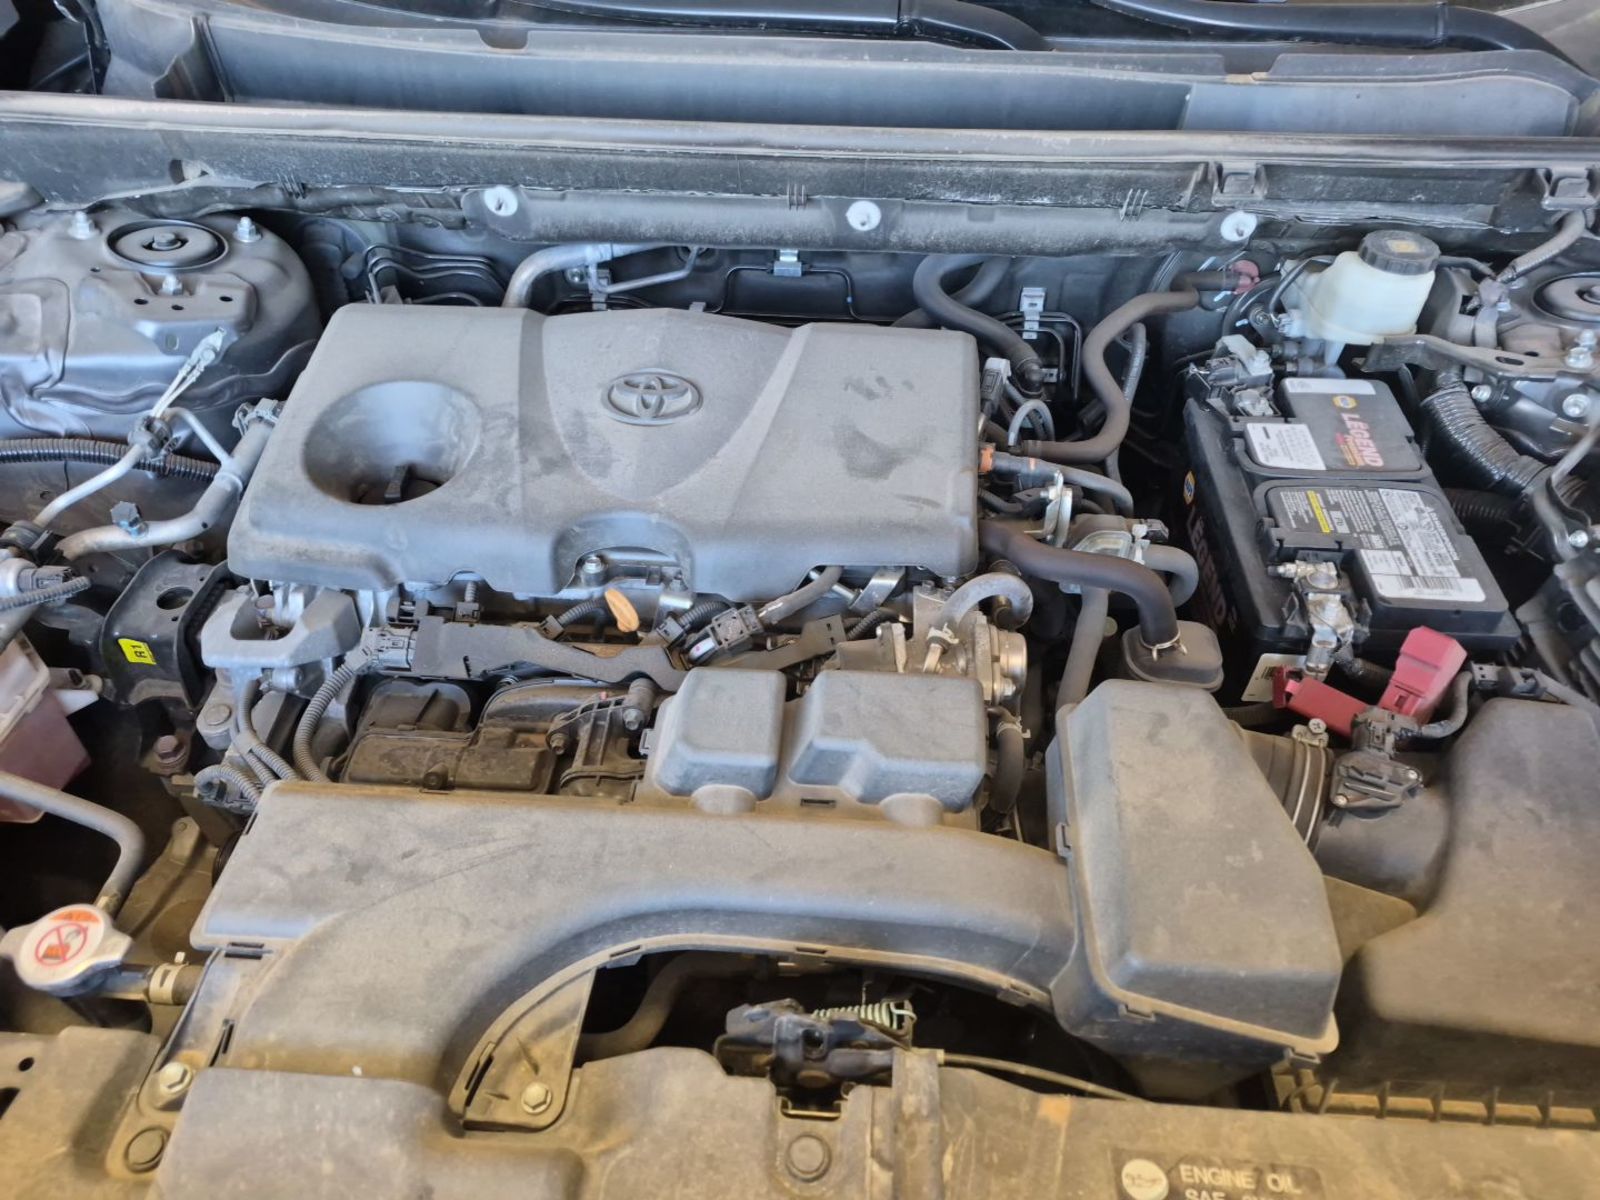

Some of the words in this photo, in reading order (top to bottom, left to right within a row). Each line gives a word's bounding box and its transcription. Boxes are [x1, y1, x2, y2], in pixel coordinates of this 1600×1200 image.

[1341, 413, 1384, 467] LEGEND
[1179, 1163, 1256, 1190] ENGINE
[1267, 1173, 1302, 1195] OIL
